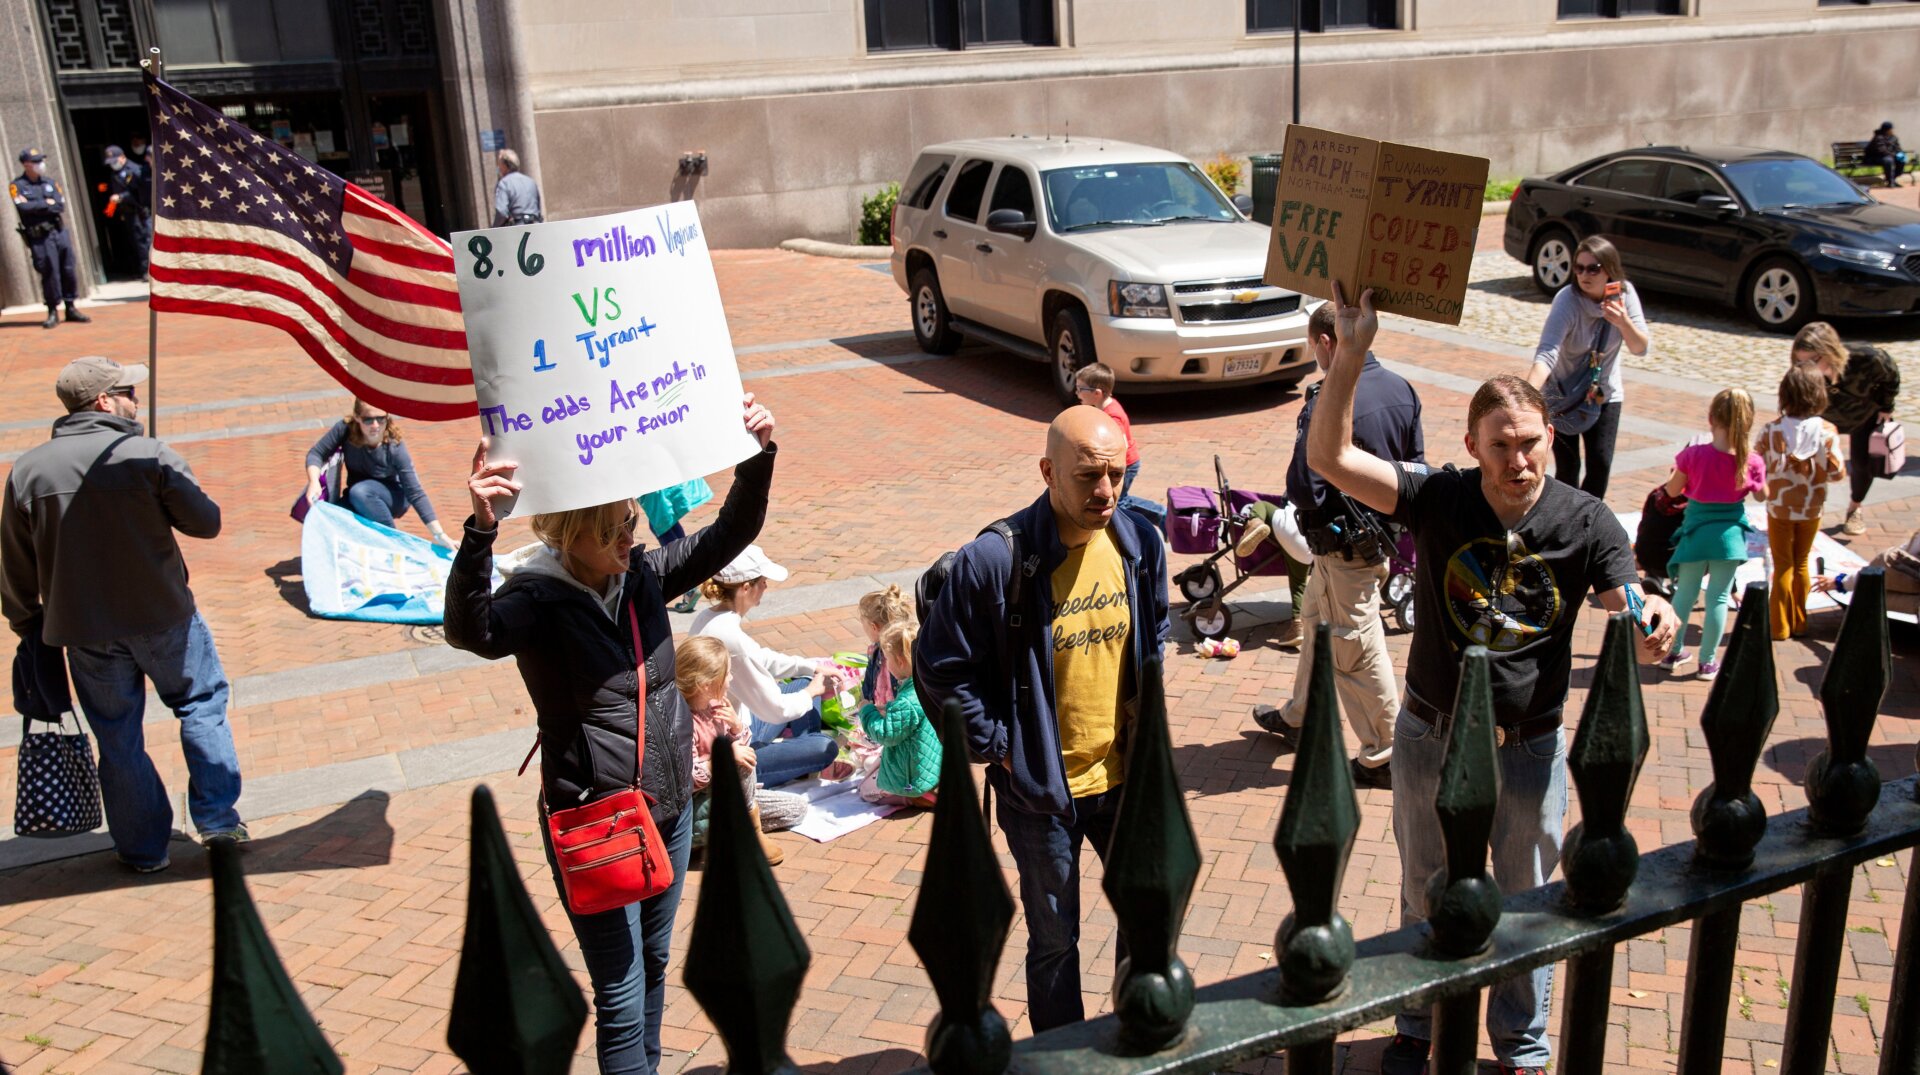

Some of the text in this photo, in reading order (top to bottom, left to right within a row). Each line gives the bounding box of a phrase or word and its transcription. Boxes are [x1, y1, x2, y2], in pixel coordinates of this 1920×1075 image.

[1291, 138, 1353, 185] RALPH
[1312, 140, 1359, 155] ARREST
[1382, 153, 1449, 177] RUNAWAY
[1377, 176, 1484, 210] TYRANT
[1280, 200, 1343, 240] FREE
[467, 231, 545, 280] 8.6
[572, 225, 657, 268] million
[1278, 231, 1329, 280] VA
[533, 316, 657, 373] 1 Tyrant
[480, 361, 706, 436] The odds Are not in
[576, 404, 690, 466] your favor
[1052, 582, 1129, 621] reedom
[1530, 560, 1555, 627] SPACE FORCE
[1053, 621, 1128, 656] keeper
